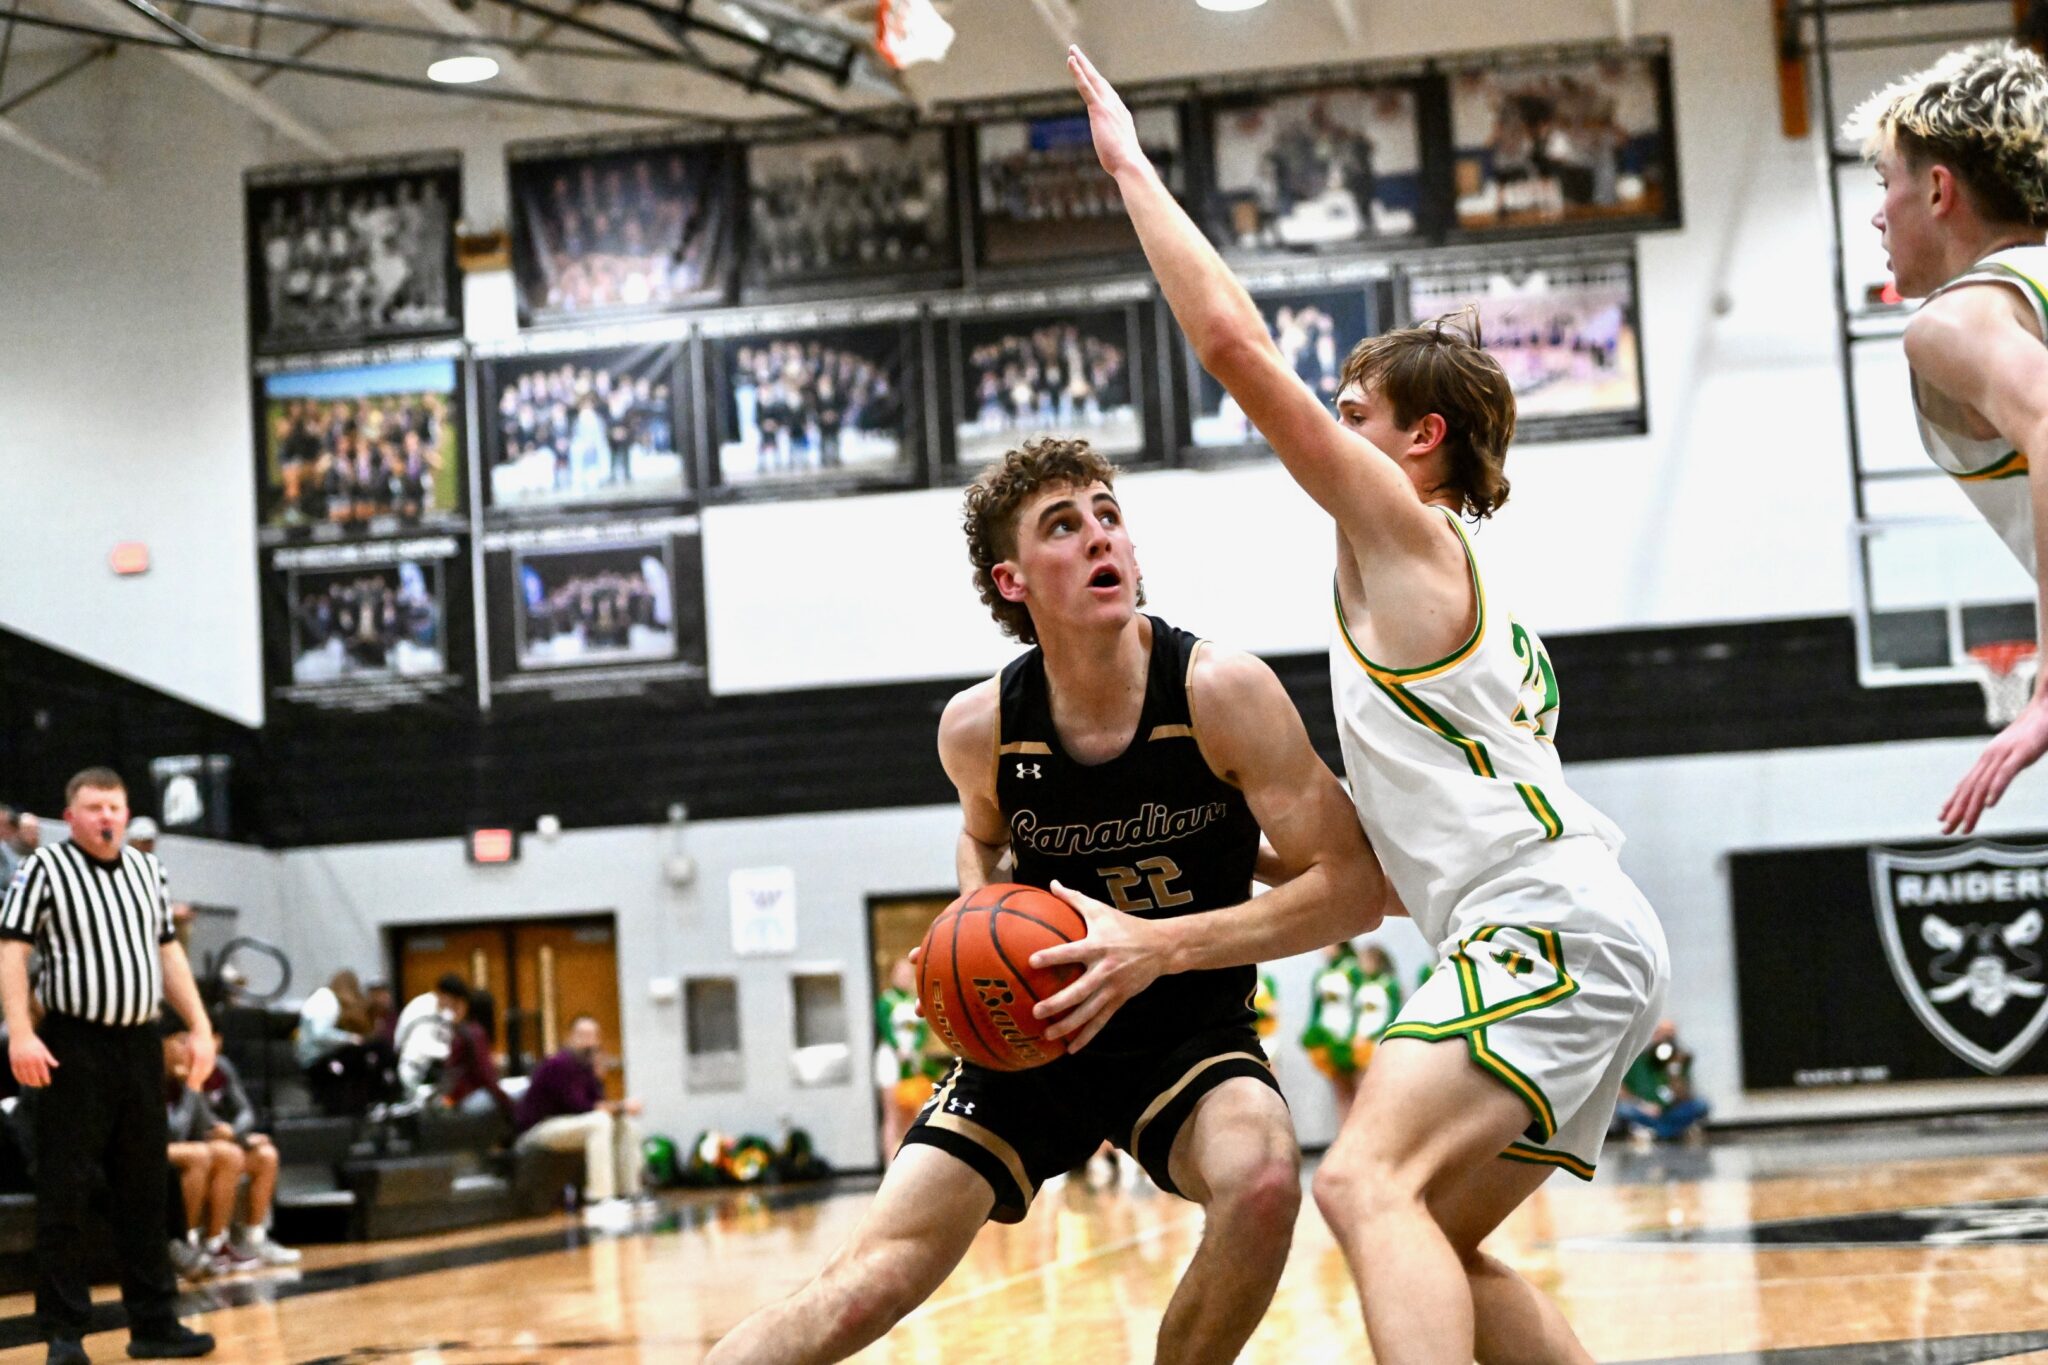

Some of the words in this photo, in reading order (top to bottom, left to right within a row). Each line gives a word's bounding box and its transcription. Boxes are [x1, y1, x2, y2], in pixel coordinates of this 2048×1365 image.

[1011, 802, 1226, 856] Canadian
[1097, 856, 1193, 911] 22
[1897, 868, 2048, 907] RAIDER
